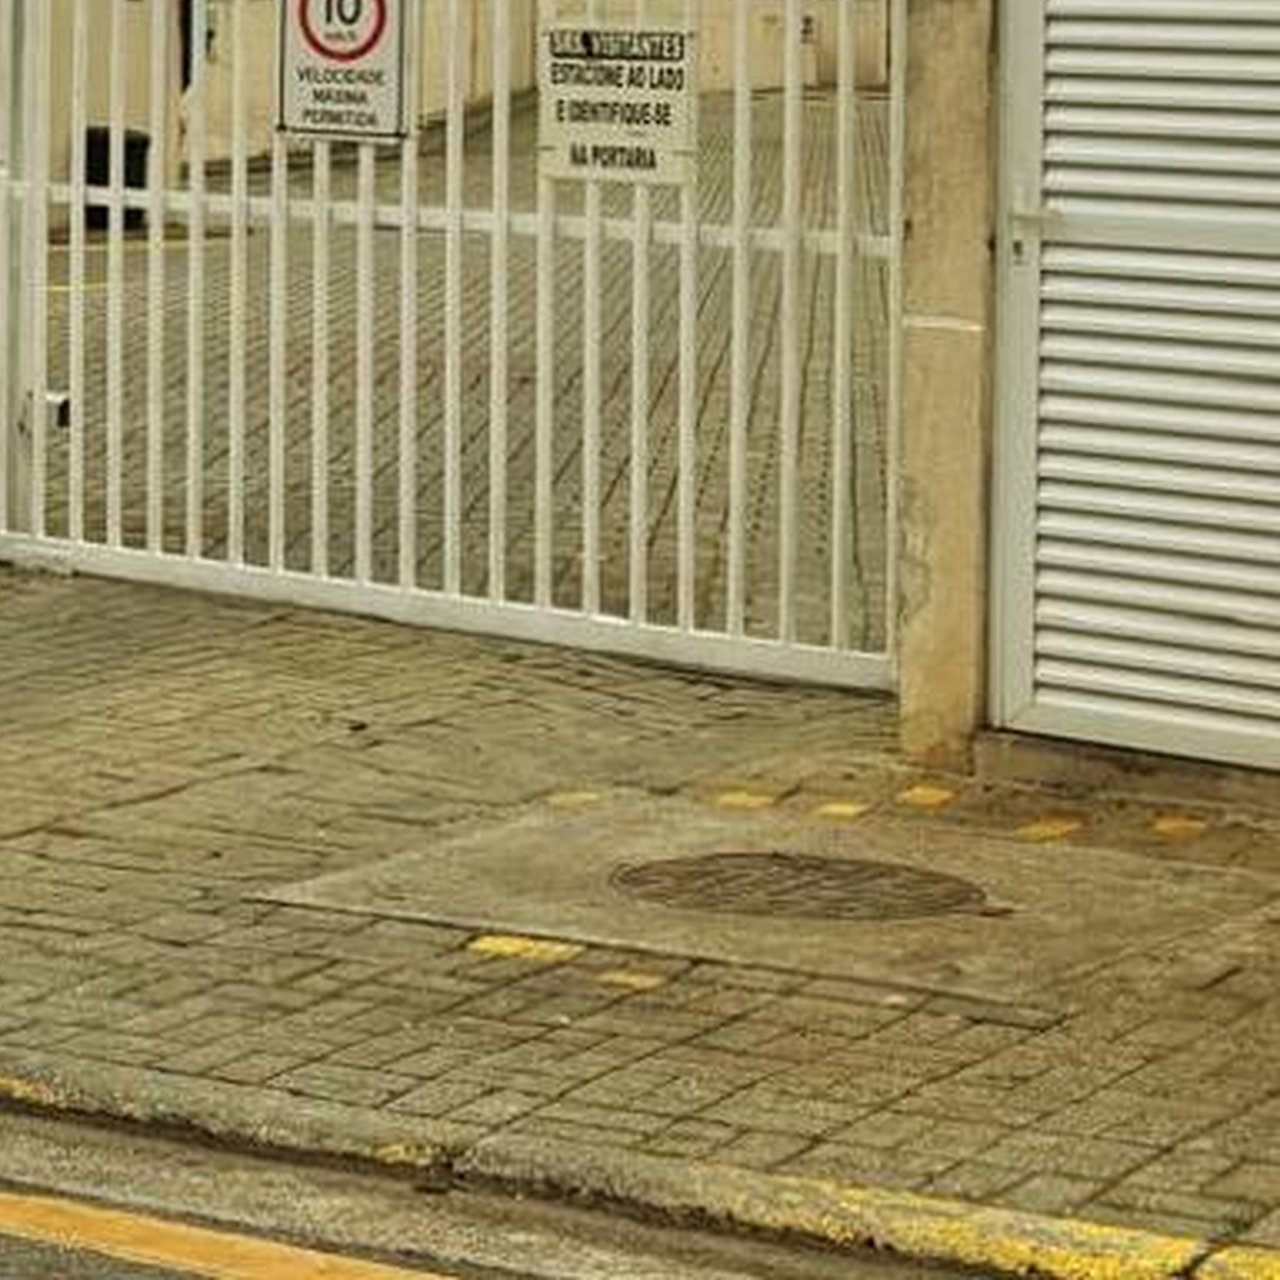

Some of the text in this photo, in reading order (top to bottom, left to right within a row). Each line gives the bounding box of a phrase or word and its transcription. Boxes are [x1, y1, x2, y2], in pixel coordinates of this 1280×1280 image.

[297, 66, 384, 86] VELOCIDADE
[551, 62, 684, 90] ESTACIONE AO LADO
[302, 108, 378, 127] PERMITIDA
[556, 99, 672, 126] E IDENTIFIQUE-SE
[570, 143, 657, 169] NA PORTARIA
